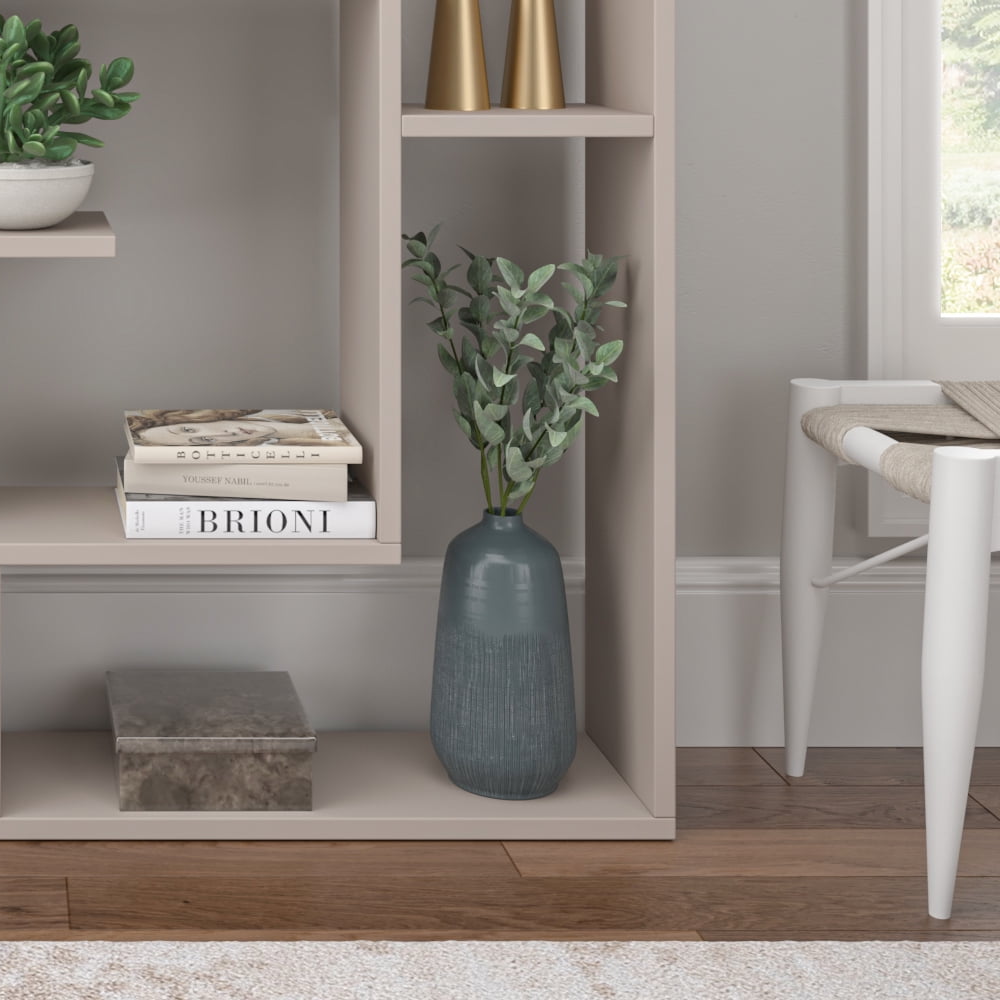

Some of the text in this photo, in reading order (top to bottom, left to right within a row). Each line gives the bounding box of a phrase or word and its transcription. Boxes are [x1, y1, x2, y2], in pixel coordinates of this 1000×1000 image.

[176, 450, 320, 460] BOTTICELLI
[183, 475, 222, 485] YOUSSEF
[196, 509, 331, 534] BRIONI
